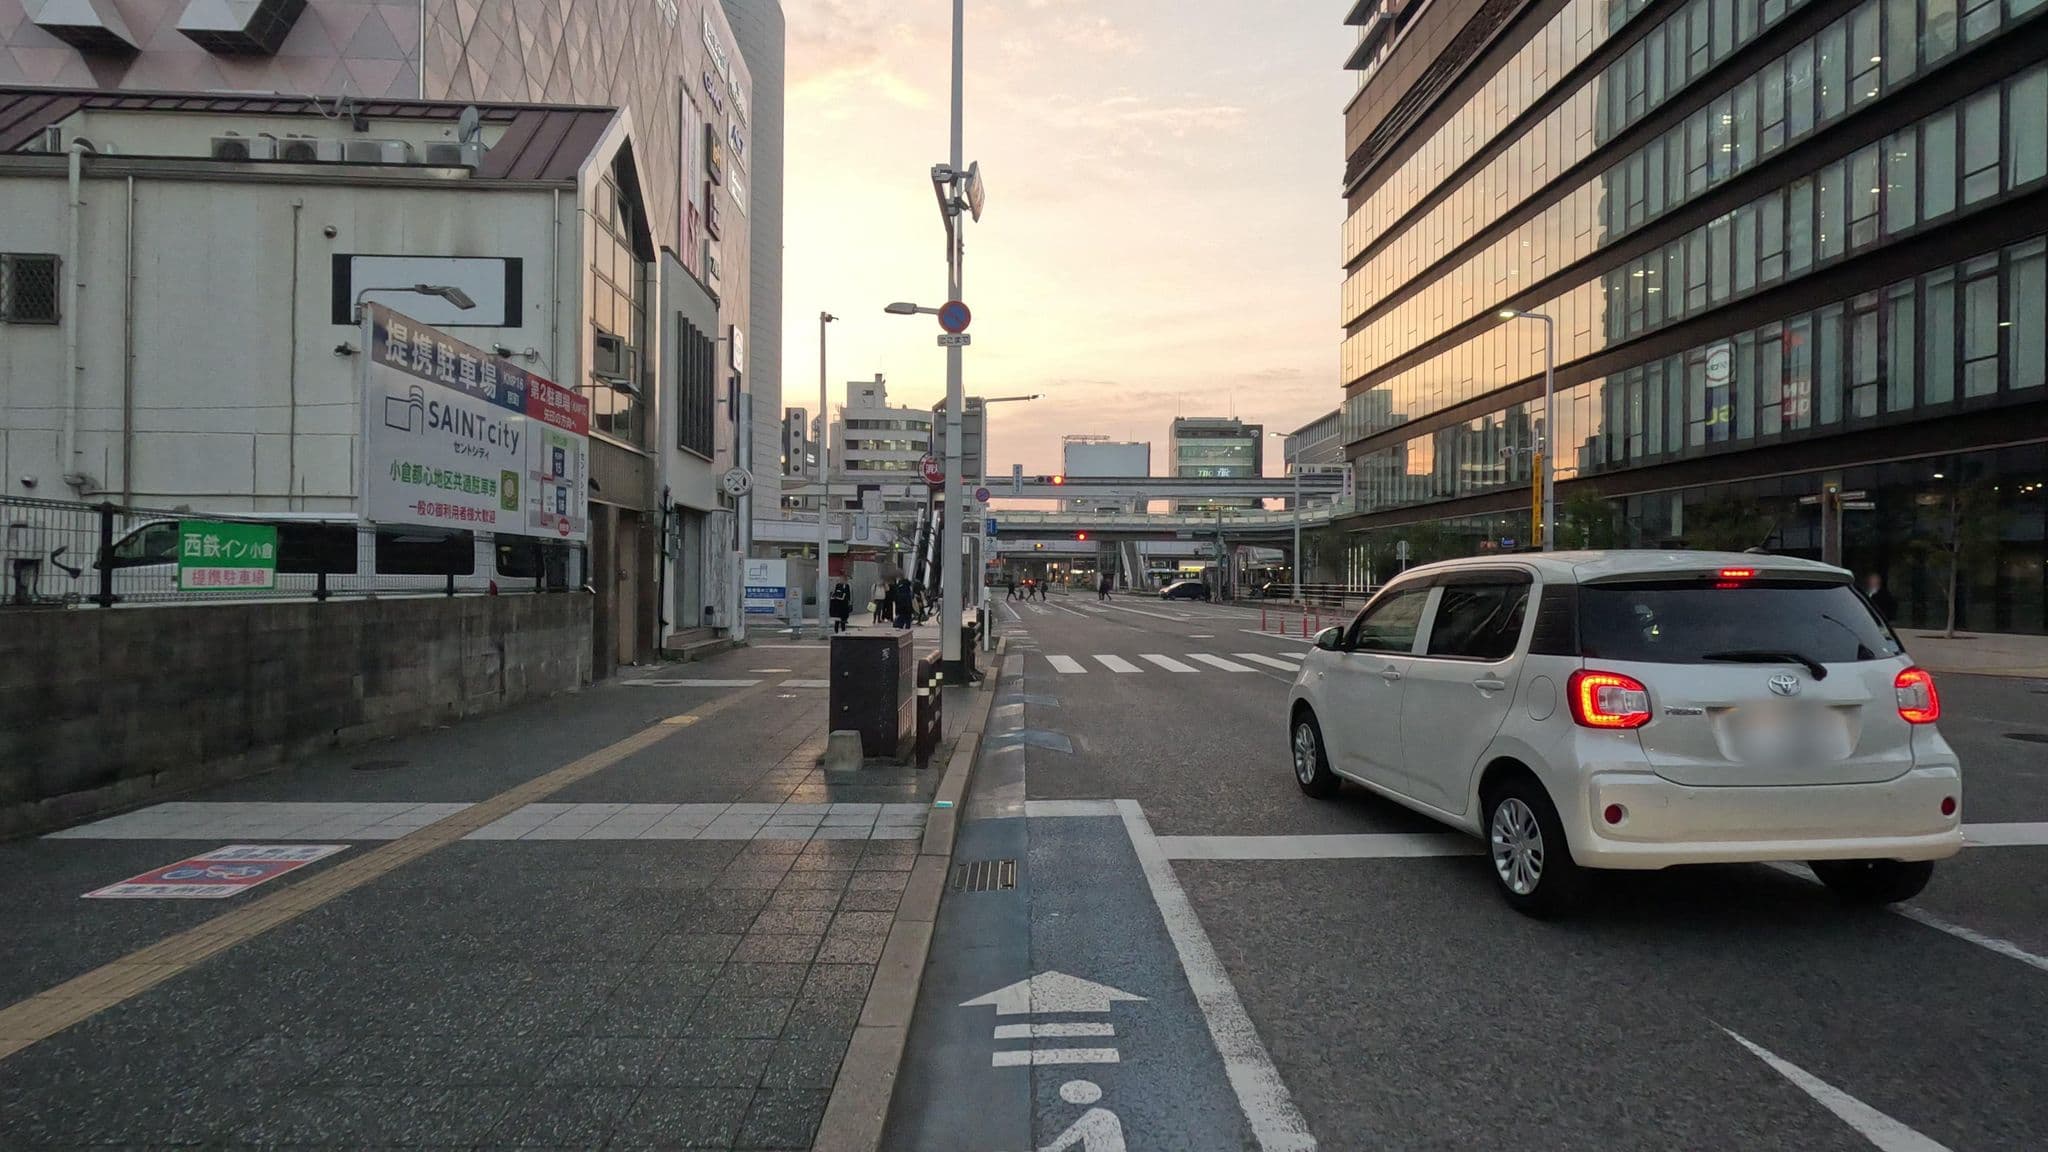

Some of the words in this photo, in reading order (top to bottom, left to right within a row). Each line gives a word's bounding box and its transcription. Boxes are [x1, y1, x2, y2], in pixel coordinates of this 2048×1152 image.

[385, 319, 497, 399] 提携駐車場
[454, 442, 490, 461] セントシティ
[192, 570, 265, 586] 提携駐車場
